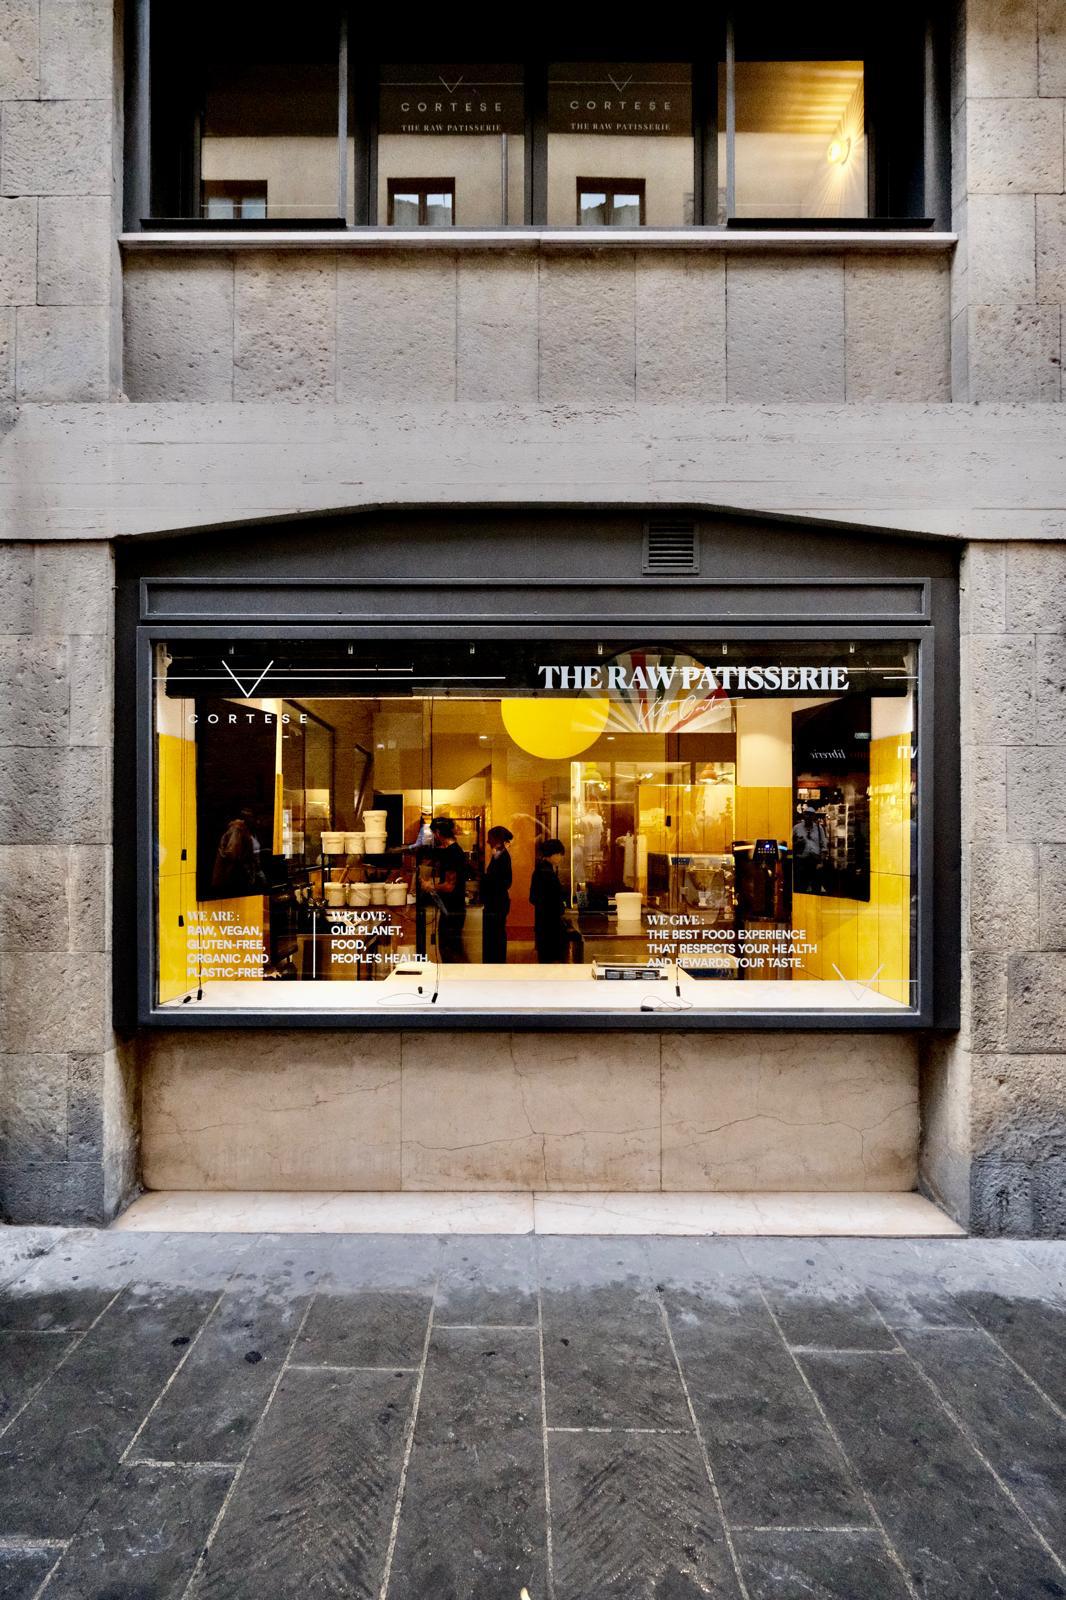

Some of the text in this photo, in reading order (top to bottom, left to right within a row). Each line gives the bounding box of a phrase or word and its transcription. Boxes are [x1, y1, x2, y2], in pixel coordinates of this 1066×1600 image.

[401, 102, 502, 112] CORTESE
[570, 101, 671, 111] CORTESE
[402, 124, 502, 132] THE RAW PATISSERIE
[571, 122, 670, 131] THE RAW PATISSERIE
[538, 665, 850, 691] THE RAW PATISSERIE
[188, 713, 309, 724] CORTESE
[187, 911, 208, 921] WE
[331, 911, 352, 921] WE
[647, 914, 669, 926] WE
[187, 926, 263, 937] RAW, VEGAN,
[331, 926, 404, 938] OUR PLANET,
[647, 929, 806, 940] THE BEST FOOD EXPERIENCE
[187, 940, 266, 951] GLUTEN-FREE,
[331, 940, 367, 951] FOOD,
[647, 943, 817, 954] THAT RESPECTS YOUR HEALTH
[187, 953, 269, 964] ORGANIC AND
[331, 953, 381, 964] PEOPLE'S
[647, 957, 805, 968] AND REWARDS YOUR TASTE.
[187, 967, 267, 978] PLASTIC-FREE.
